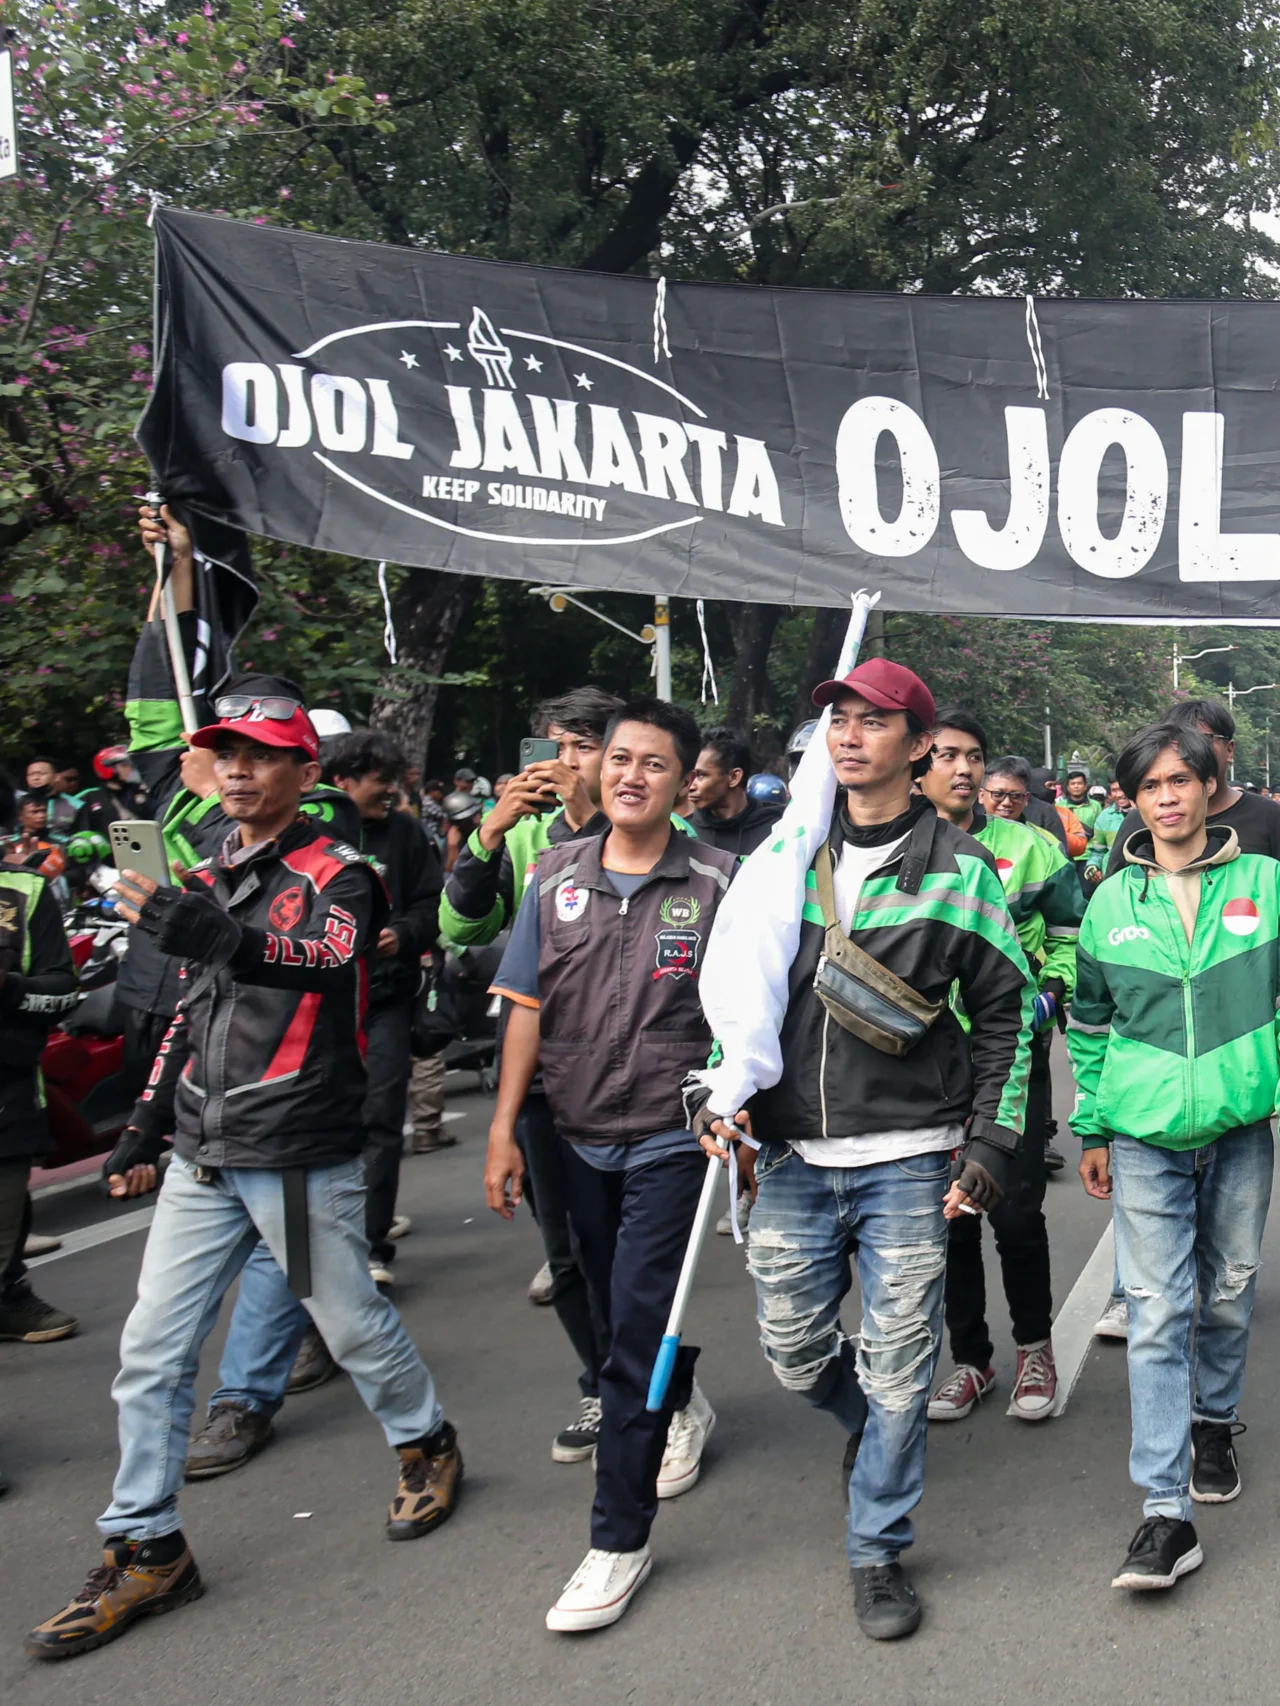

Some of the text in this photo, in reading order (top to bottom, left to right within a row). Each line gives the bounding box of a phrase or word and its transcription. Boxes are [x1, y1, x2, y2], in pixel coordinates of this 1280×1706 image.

[221, 361, 787, 528] OJOL JAKARTA
[422, 475, 608, 522] KEEP SOLIDARITY
[671, 907, 690, 918] WB
